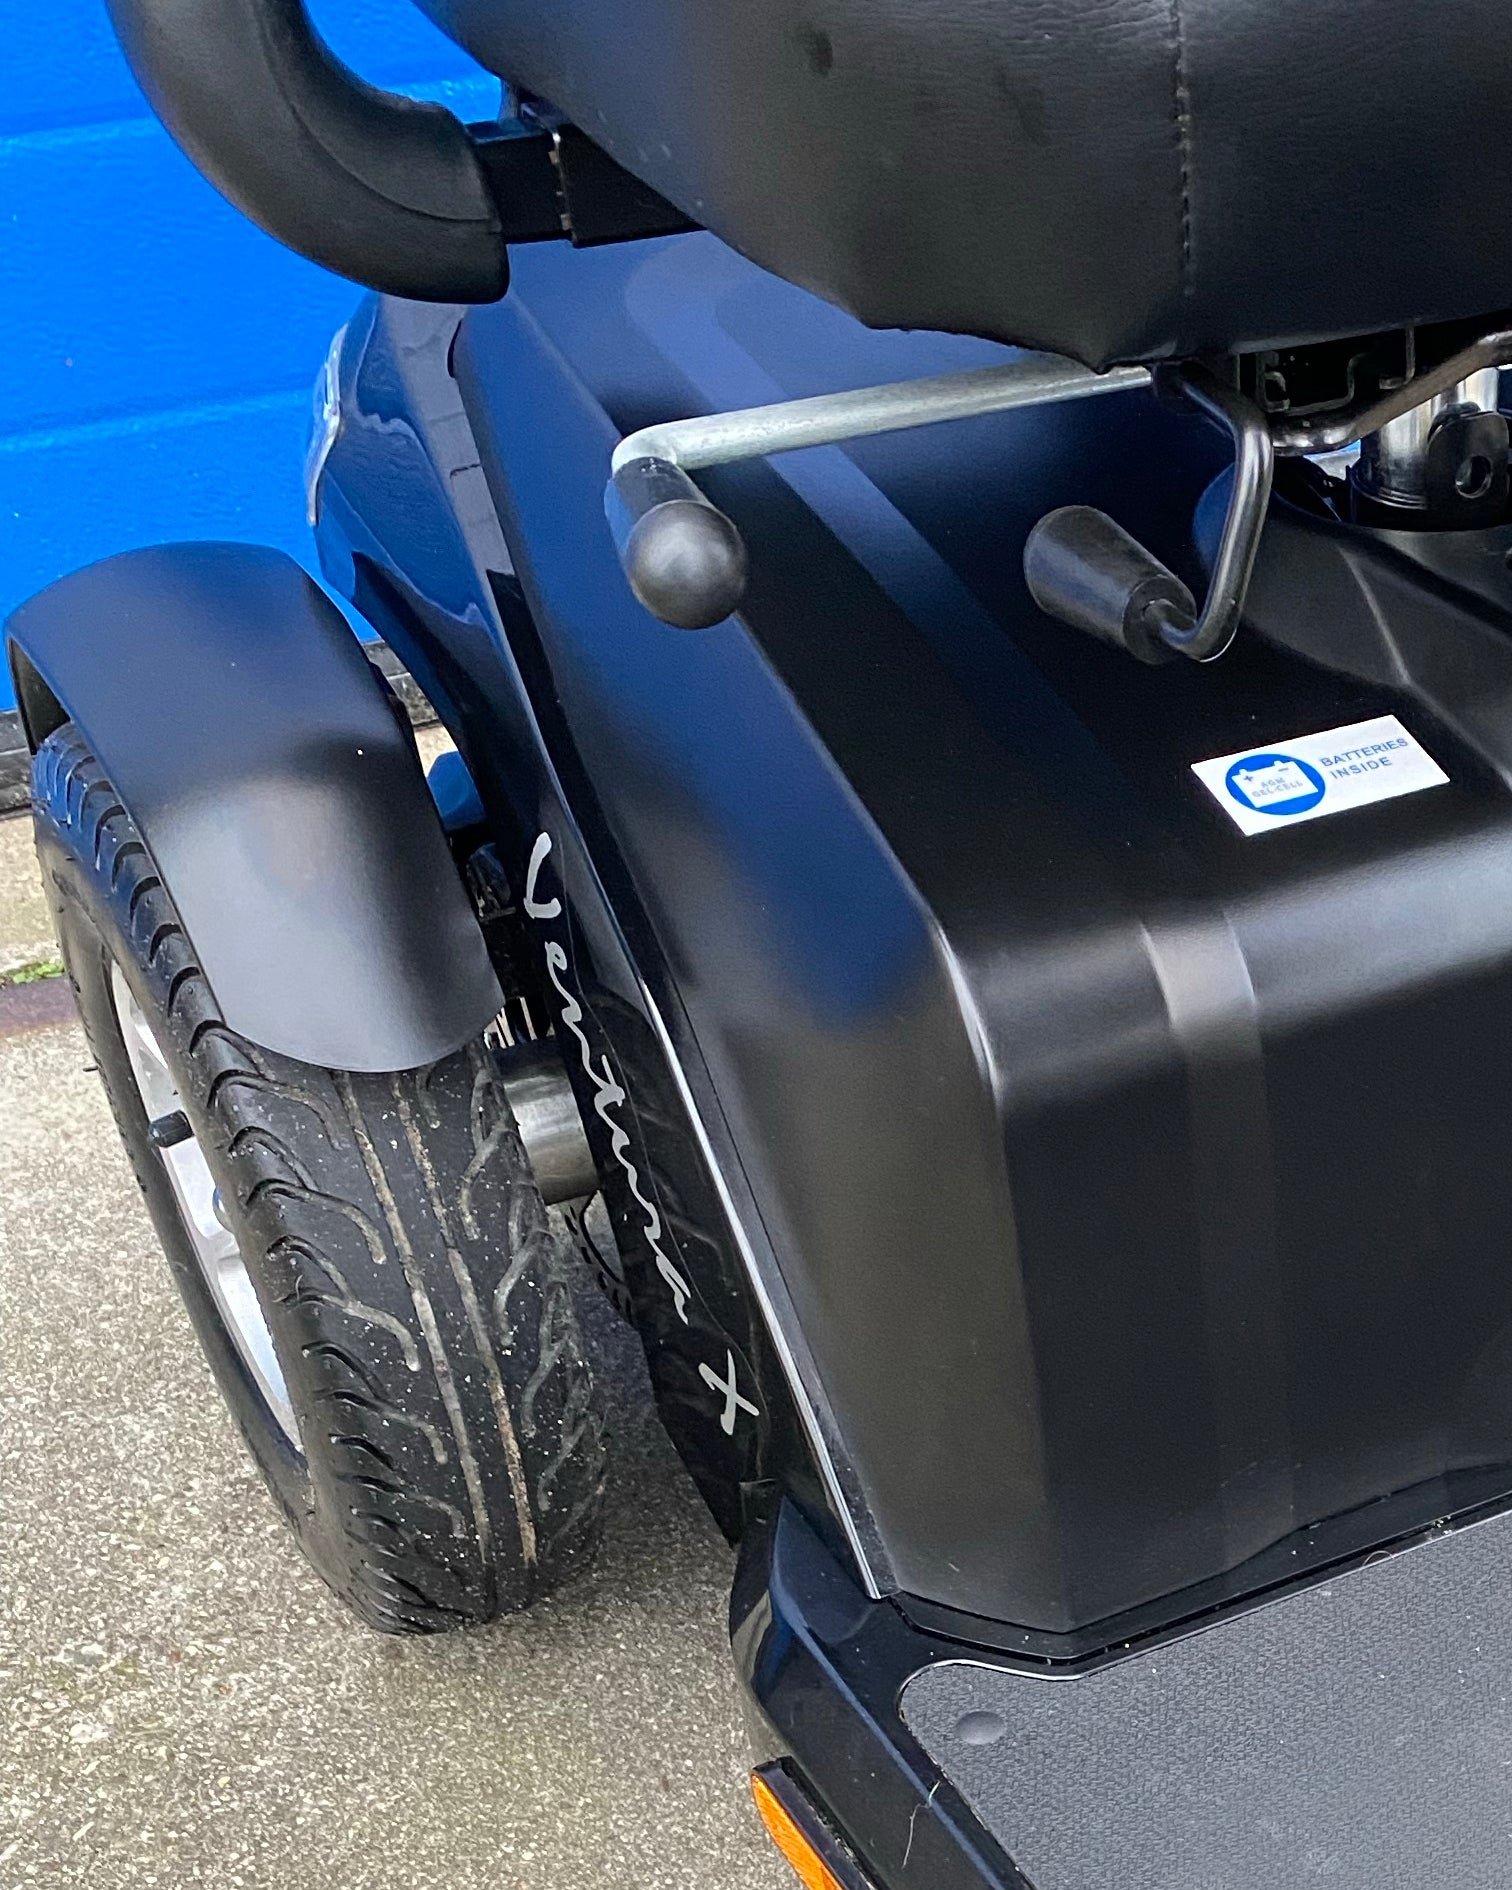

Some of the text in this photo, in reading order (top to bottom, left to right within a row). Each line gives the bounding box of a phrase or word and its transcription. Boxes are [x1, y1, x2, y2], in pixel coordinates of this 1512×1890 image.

[1318, 737, 1409, 767] BATTERIES
[1330, 756, 1393, 780] INSIDE
[523, 830, 691, 1326] Ventura
